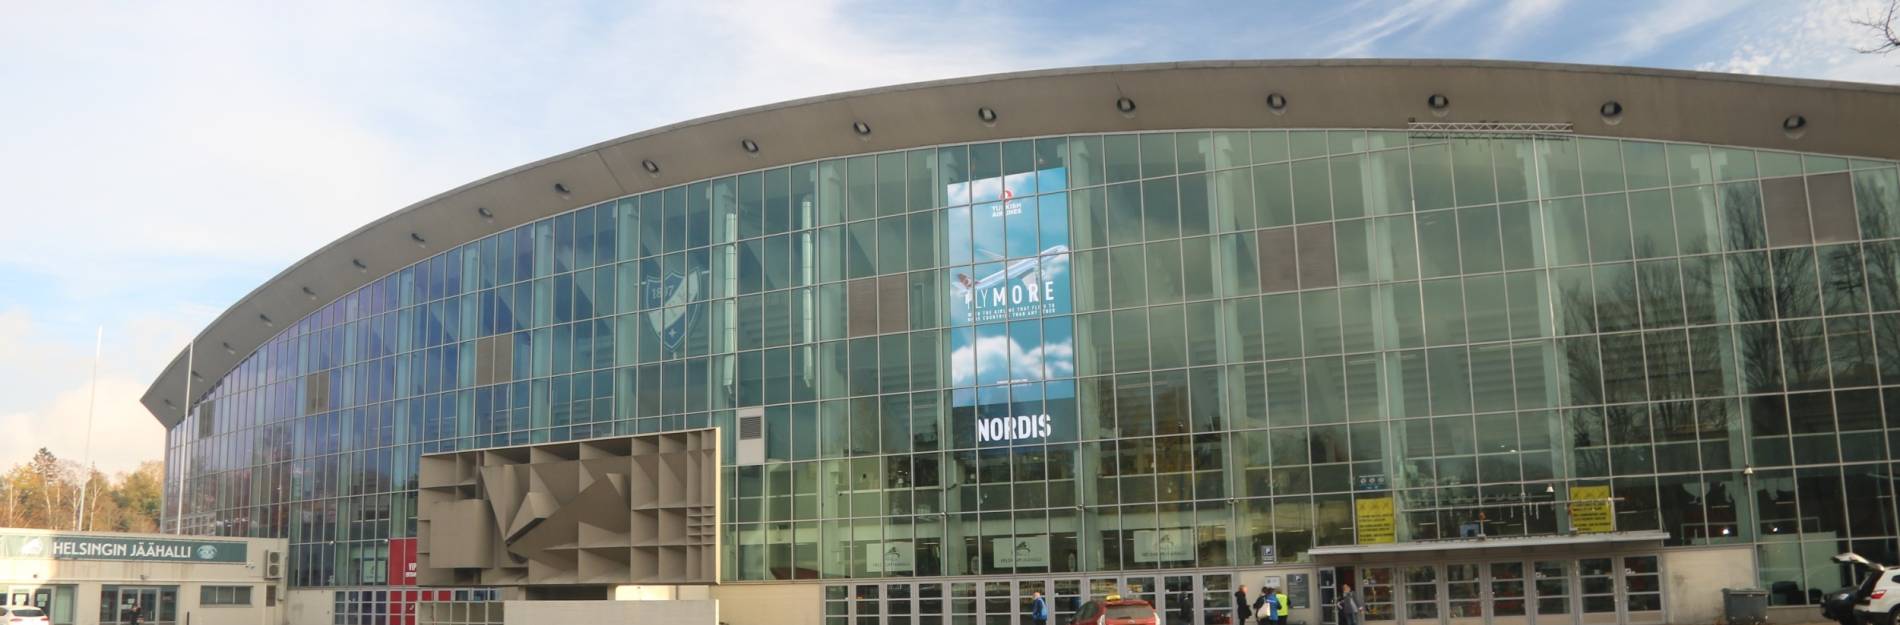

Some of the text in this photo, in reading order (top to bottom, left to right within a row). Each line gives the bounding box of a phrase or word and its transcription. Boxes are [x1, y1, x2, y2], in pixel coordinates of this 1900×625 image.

[992, 202, 1022, 211] TUKISH
[992, 208, 1022, 217] AIRINES
[652, 285, 674, 299] 187
[978, 414, 1052, 442] NORDIS
[53, 541, 191, 558] HELSINGIN JÄÄHALLI
